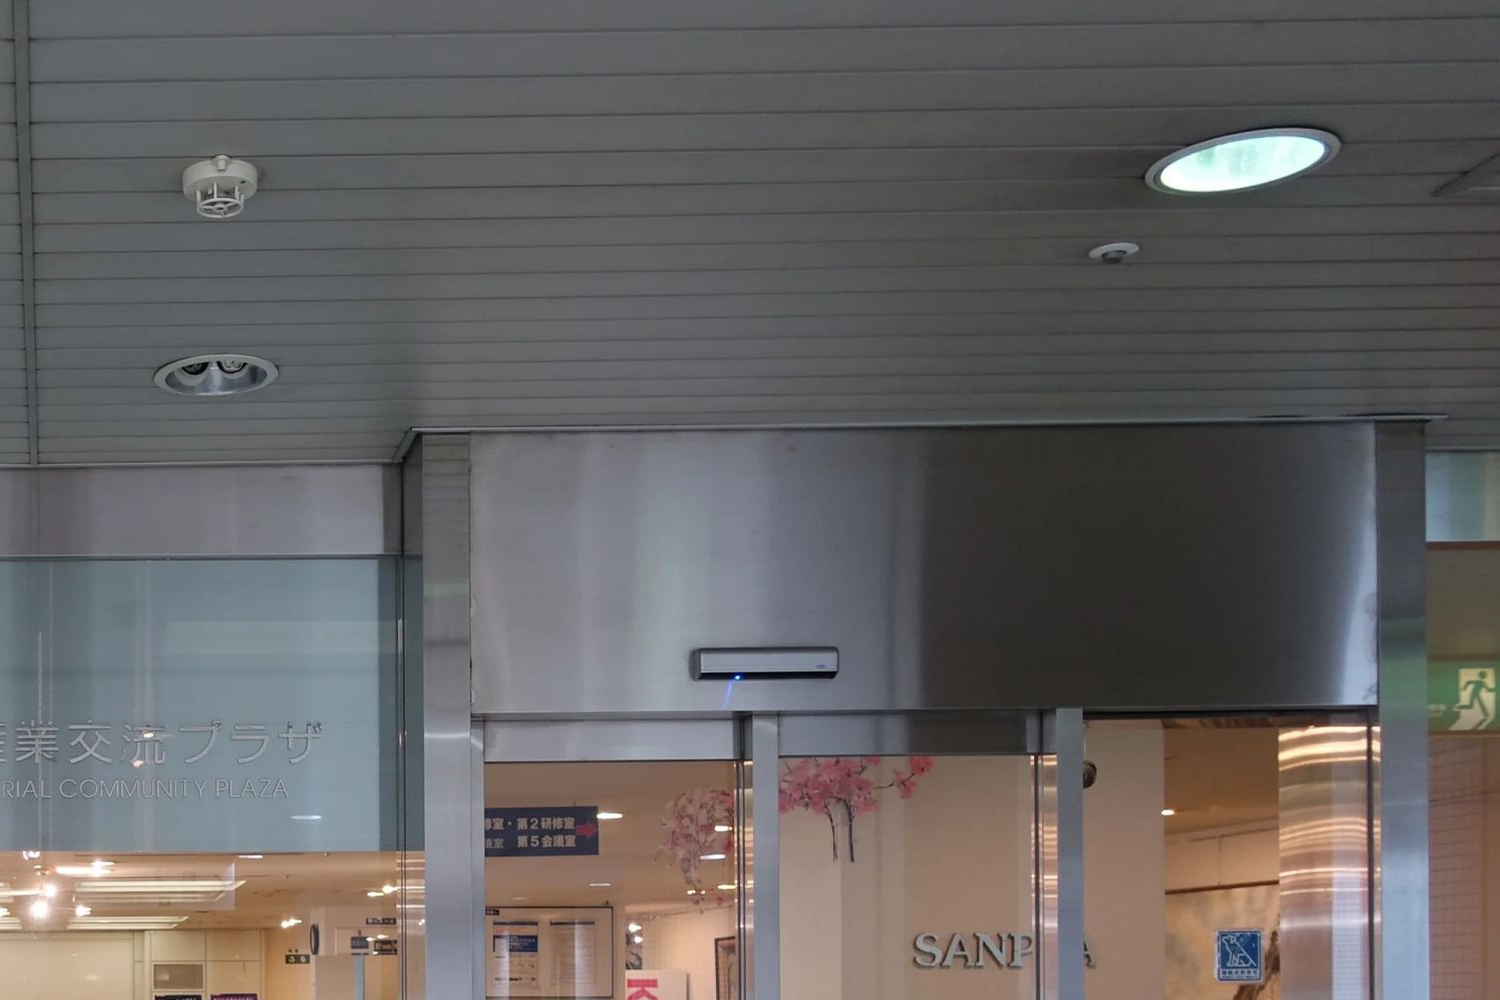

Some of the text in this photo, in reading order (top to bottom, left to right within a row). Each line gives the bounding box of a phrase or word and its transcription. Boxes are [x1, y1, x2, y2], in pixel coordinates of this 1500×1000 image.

[59, 778, 207, 800] COMMUNITY
[214, 778, 289, 800] PLAZA
[517, 835, 576, 848] 第5会議室
